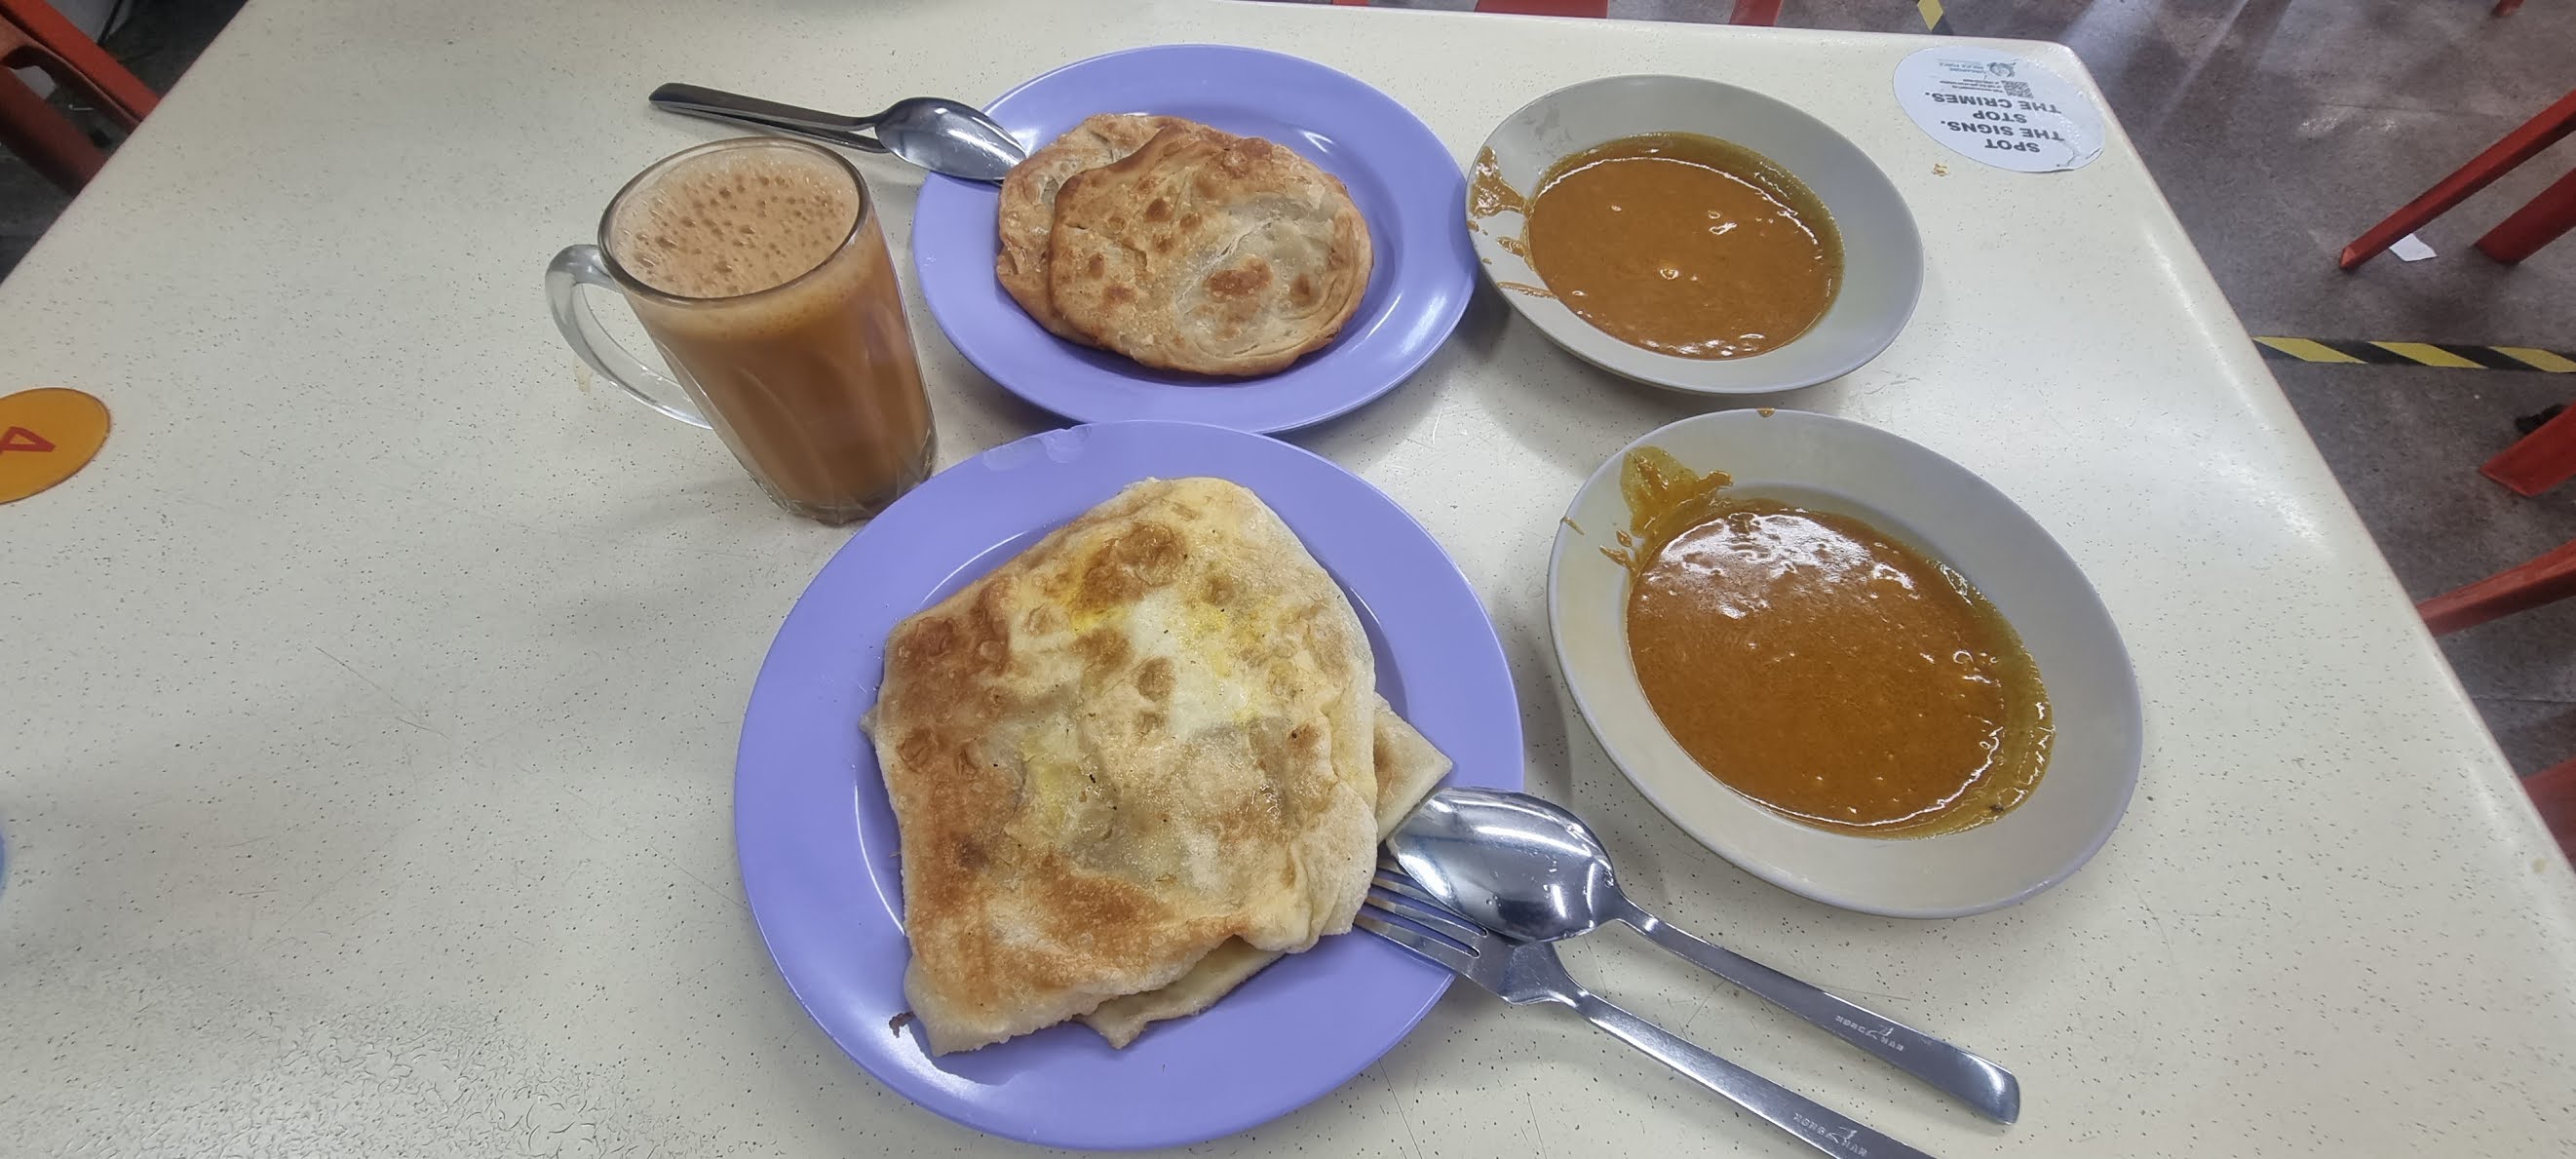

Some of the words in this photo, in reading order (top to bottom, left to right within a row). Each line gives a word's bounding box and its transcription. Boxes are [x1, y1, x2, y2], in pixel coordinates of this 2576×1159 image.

[1925, 92, 2013, 108] CRIMES.
[2019, 100, 2062, 114] THE
[1973, 110, 2027, 124] STOP
[1941, 120, 2014, 135] SIGNS.
[2019, 128, 2064, 141] THE
[1984, 138, 2041, 153] SPOT
